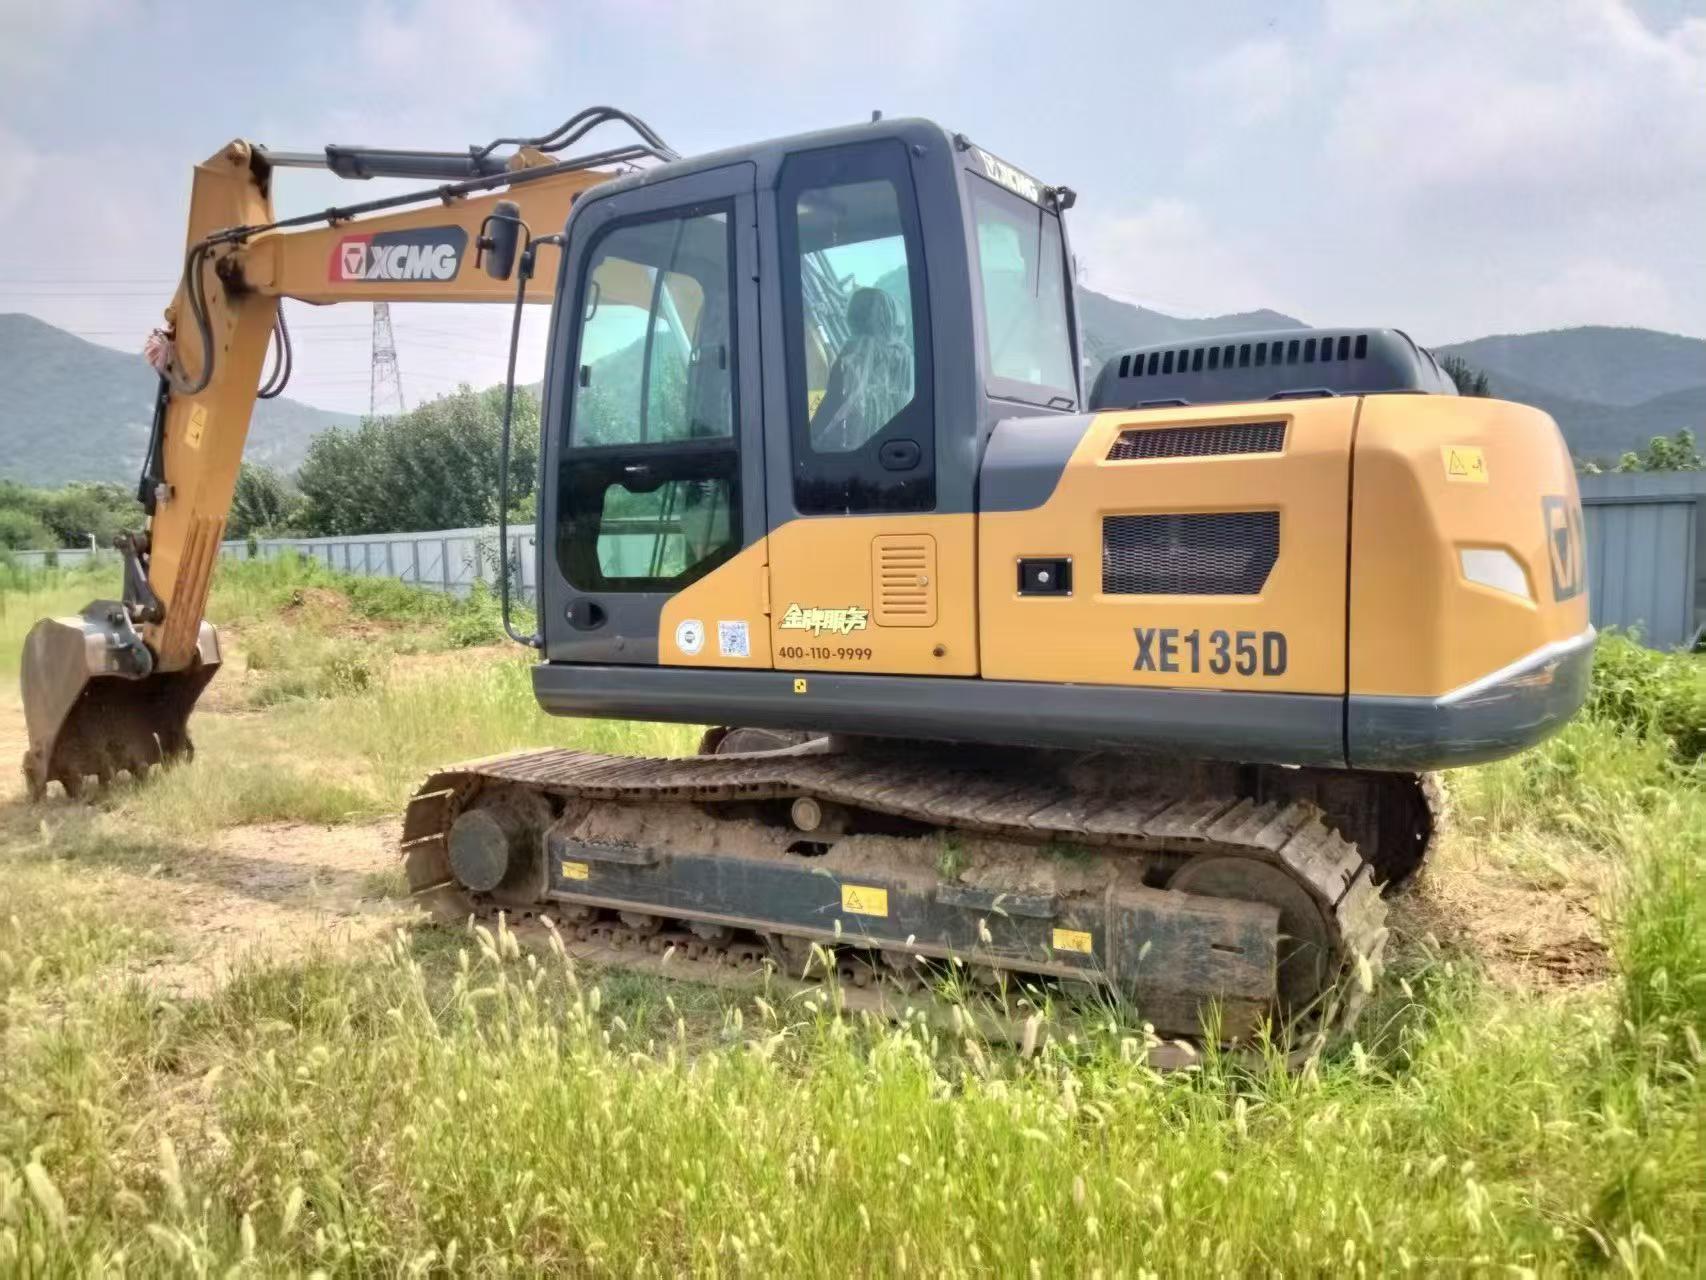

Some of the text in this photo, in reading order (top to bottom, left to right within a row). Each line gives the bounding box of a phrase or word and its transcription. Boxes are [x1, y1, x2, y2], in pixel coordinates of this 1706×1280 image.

[366, 244, 457, 280] XCMG
[779, 603, 869, 637] 金牌服务
[779, 647, 872, 660] 400-110-9999
[1133, 628, 1288, 676] XE135D
